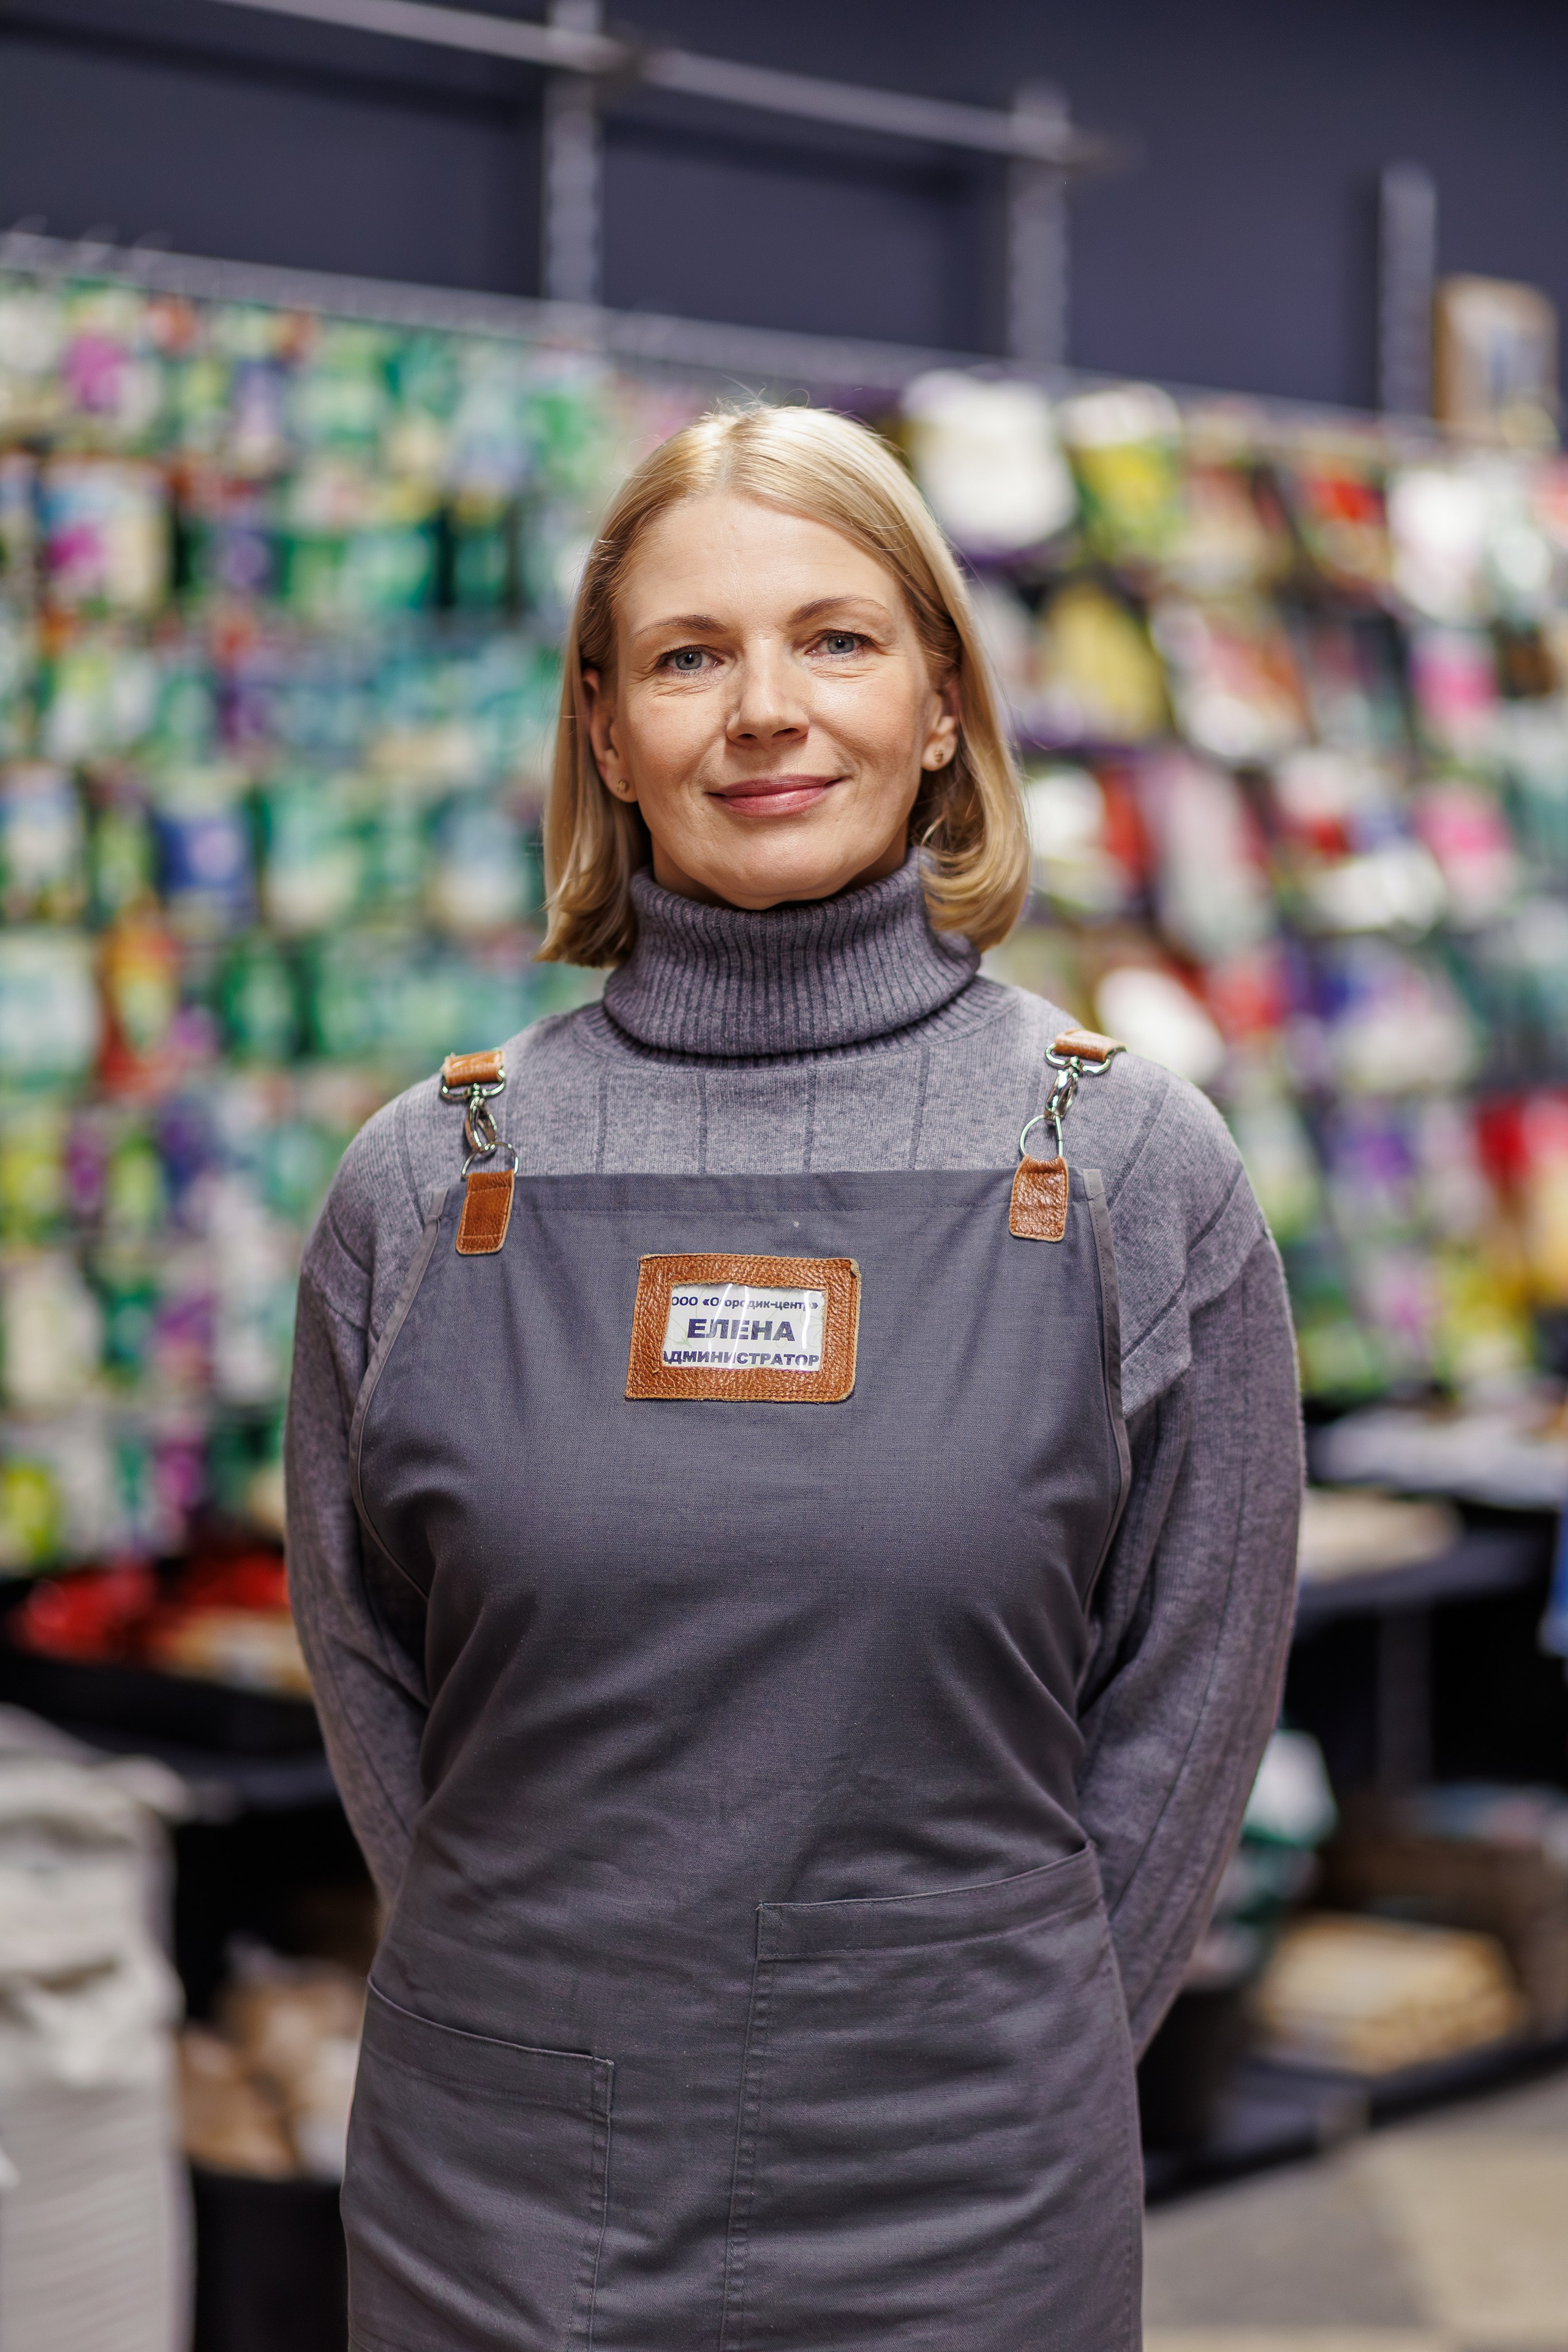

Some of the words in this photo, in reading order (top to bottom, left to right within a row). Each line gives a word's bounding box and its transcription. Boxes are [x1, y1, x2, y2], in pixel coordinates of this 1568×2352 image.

[672, 1296, 698, 1306] ООО
[703, 1297, 818, 1311] «Оородик-цент»
[687, 1318, 795, 1341] ЕЛЕНА
